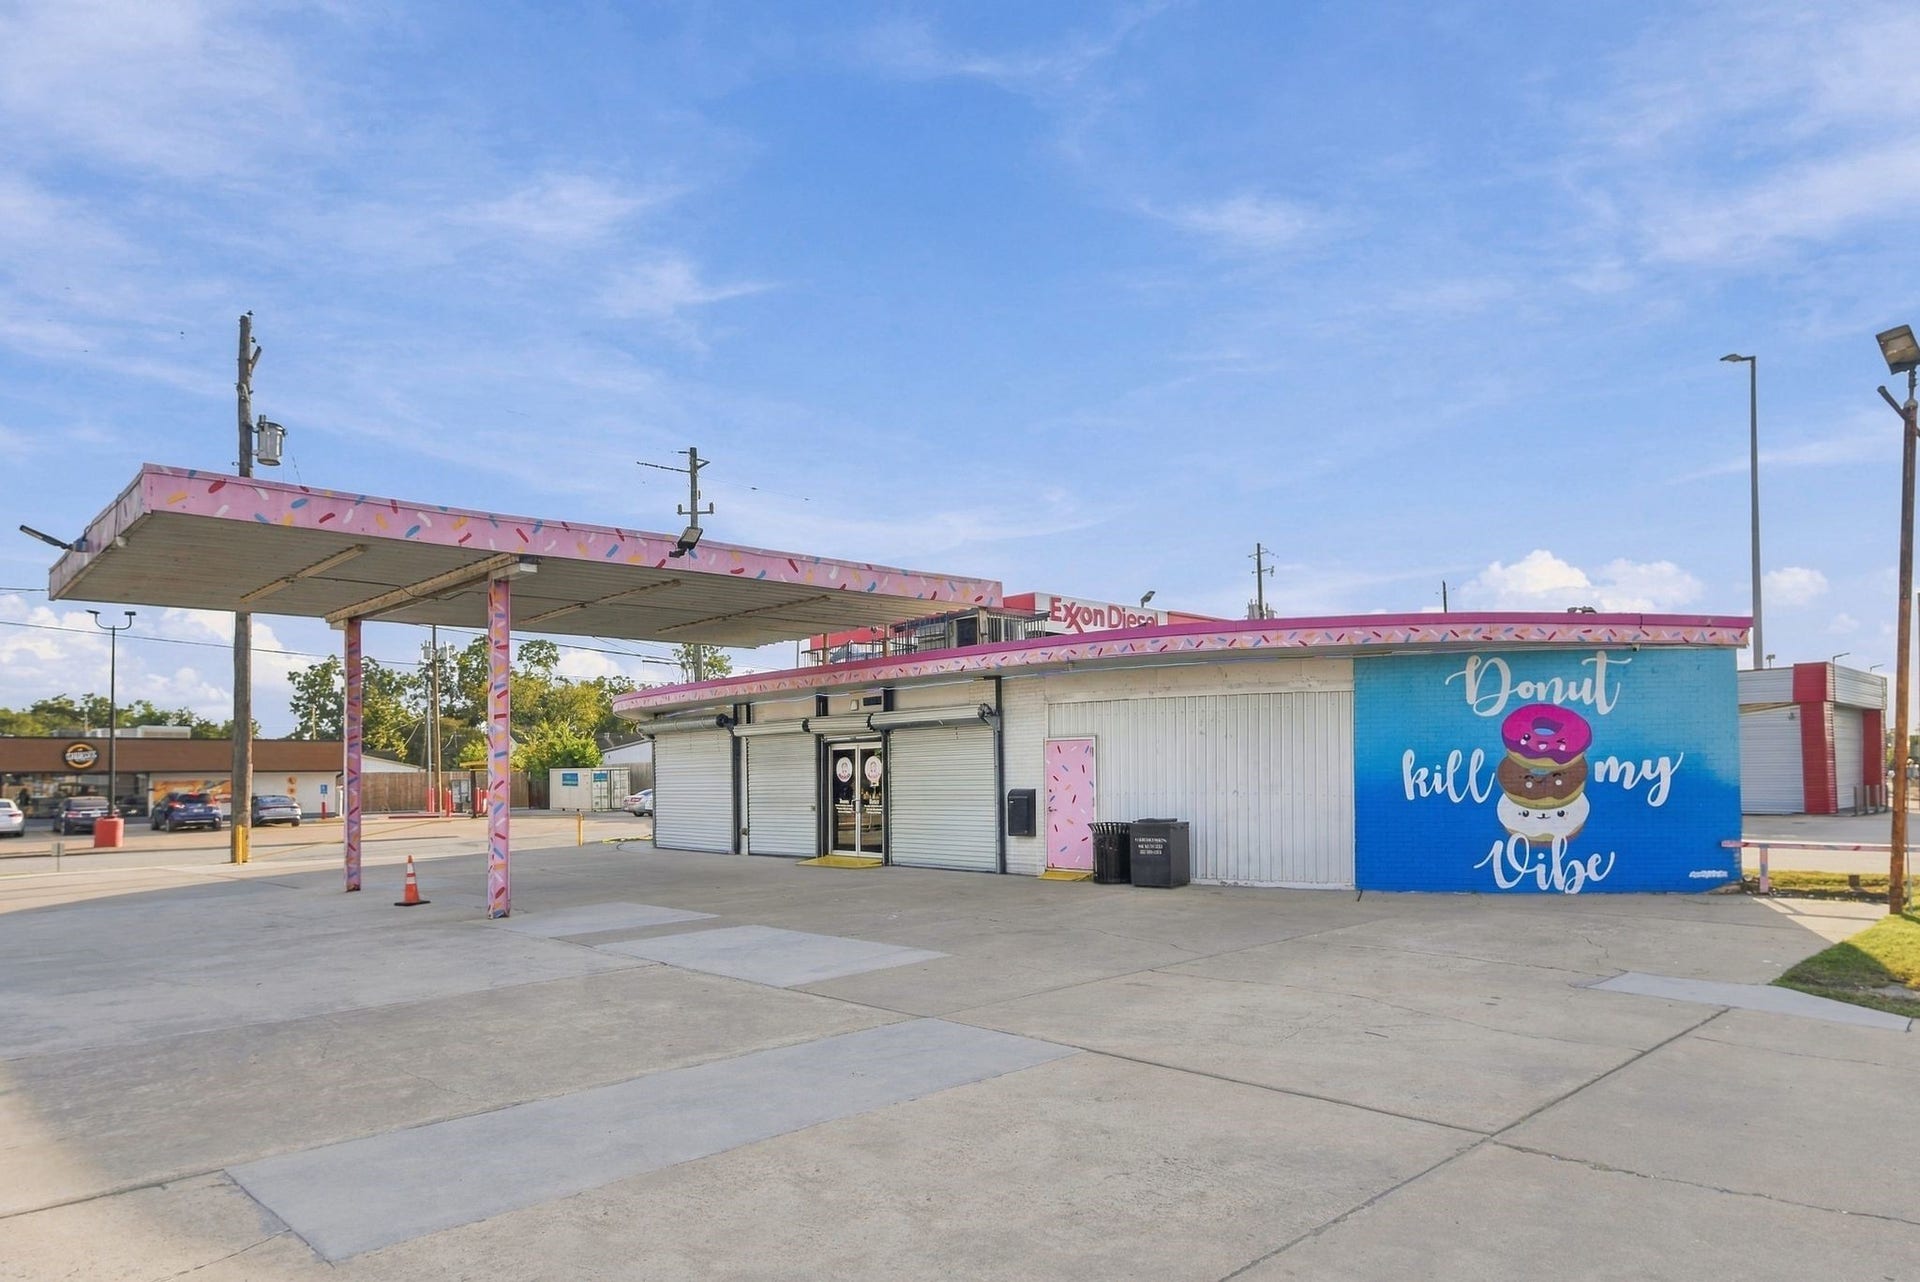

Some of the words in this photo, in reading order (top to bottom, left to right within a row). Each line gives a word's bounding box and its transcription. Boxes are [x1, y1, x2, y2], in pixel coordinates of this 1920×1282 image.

[1049, 597, 1105, 633] Exxon
[1445, 650, 1632, 717] Donut
[1402, 748, 1496, 804] kill
[1594, 751, 1684, 807] my
[1473, 832, 1616, 894] Vibe
